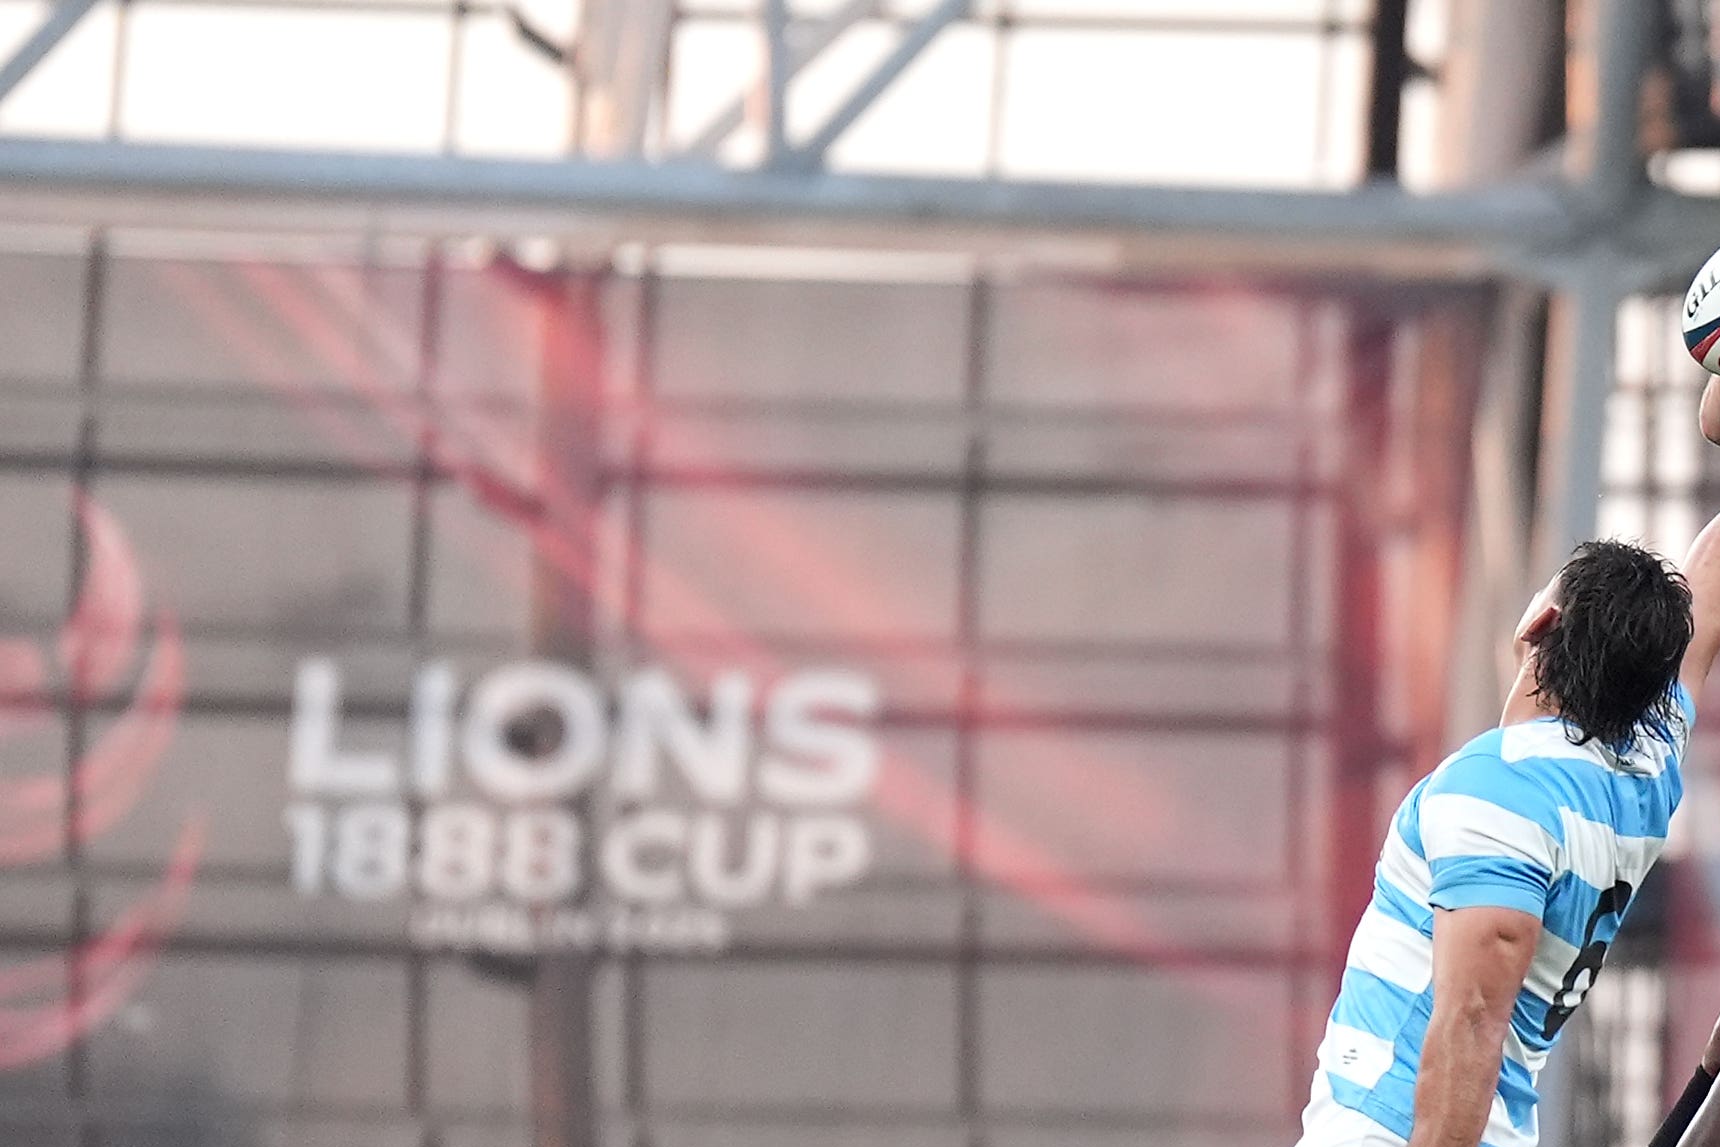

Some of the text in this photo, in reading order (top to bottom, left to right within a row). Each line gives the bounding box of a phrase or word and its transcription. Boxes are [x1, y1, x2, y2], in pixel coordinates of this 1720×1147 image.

[287, 657, 883, 805] LIONS
[286, 803, 875, 907] 1888 CUP
